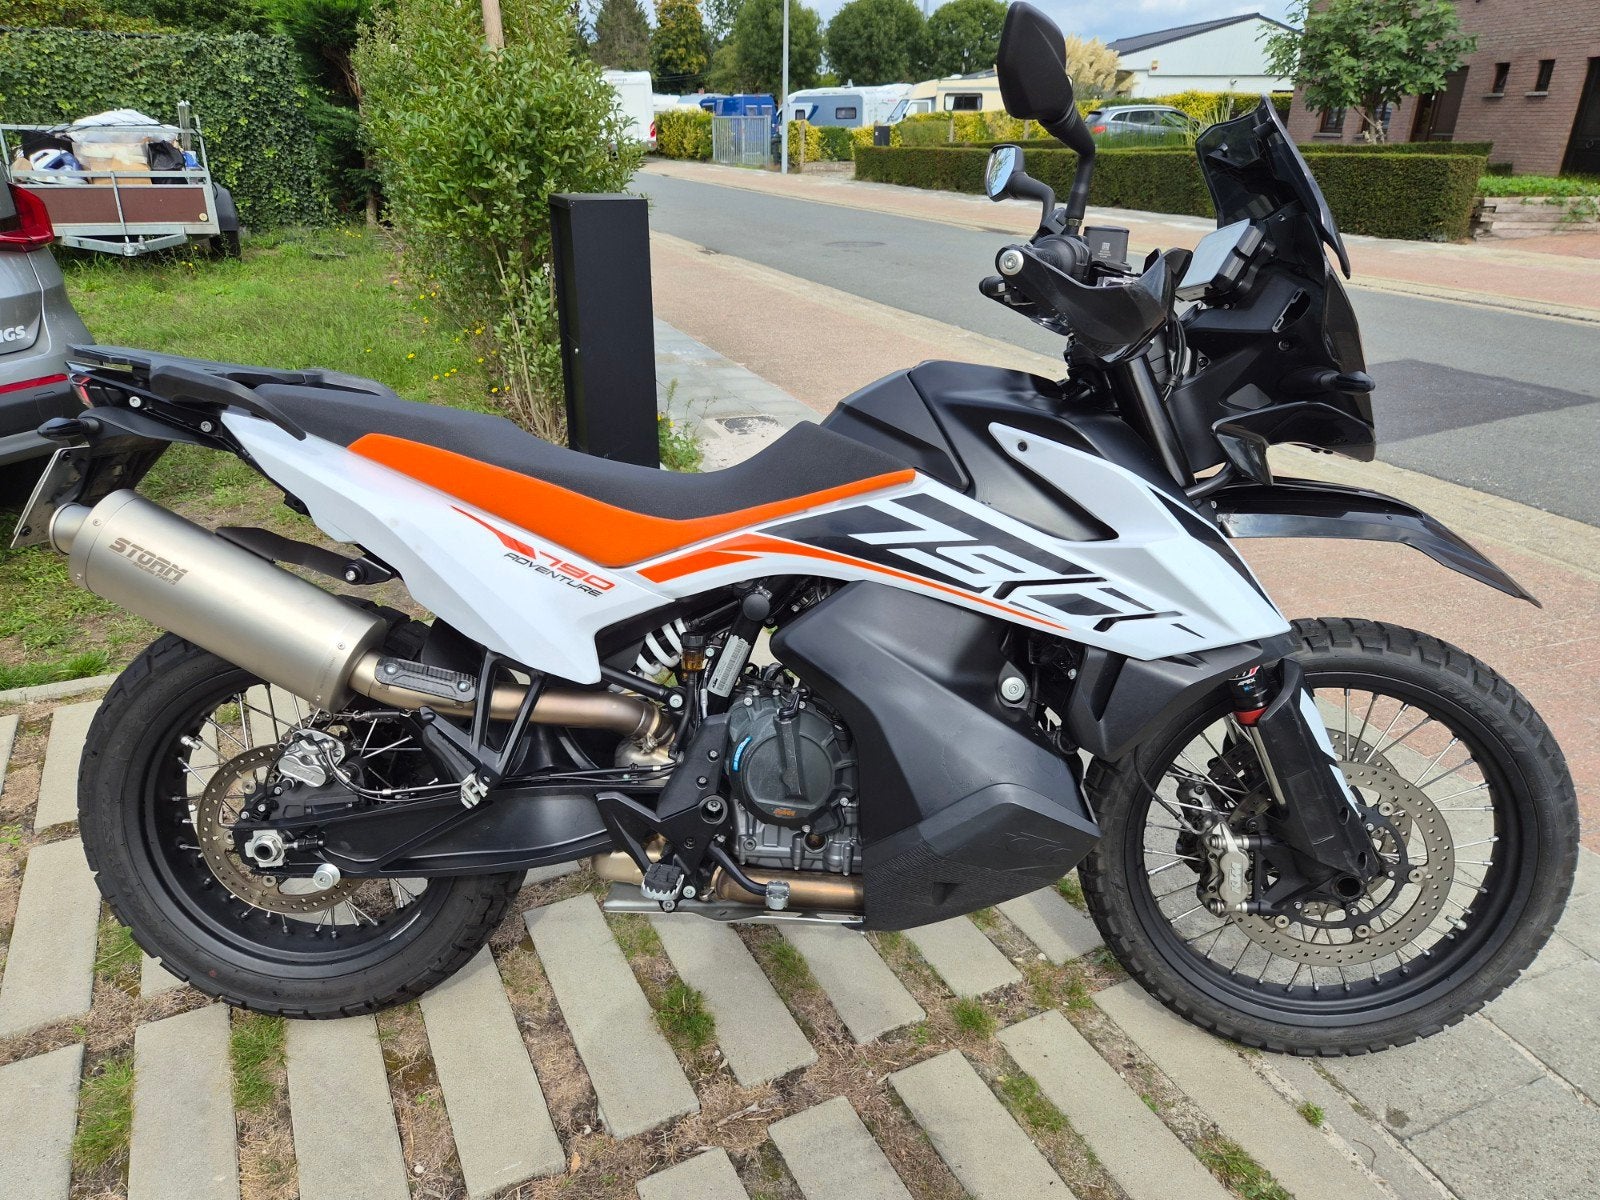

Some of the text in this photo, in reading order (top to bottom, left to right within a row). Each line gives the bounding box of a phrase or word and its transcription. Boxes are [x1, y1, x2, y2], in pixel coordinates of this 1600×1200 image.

[108, 537, 189, 582] STORM
[503, 552, 603, 597] ADVENTURE
[539, 551, 615, 591] 790
[1229, 861, 1243, 895] KTM
